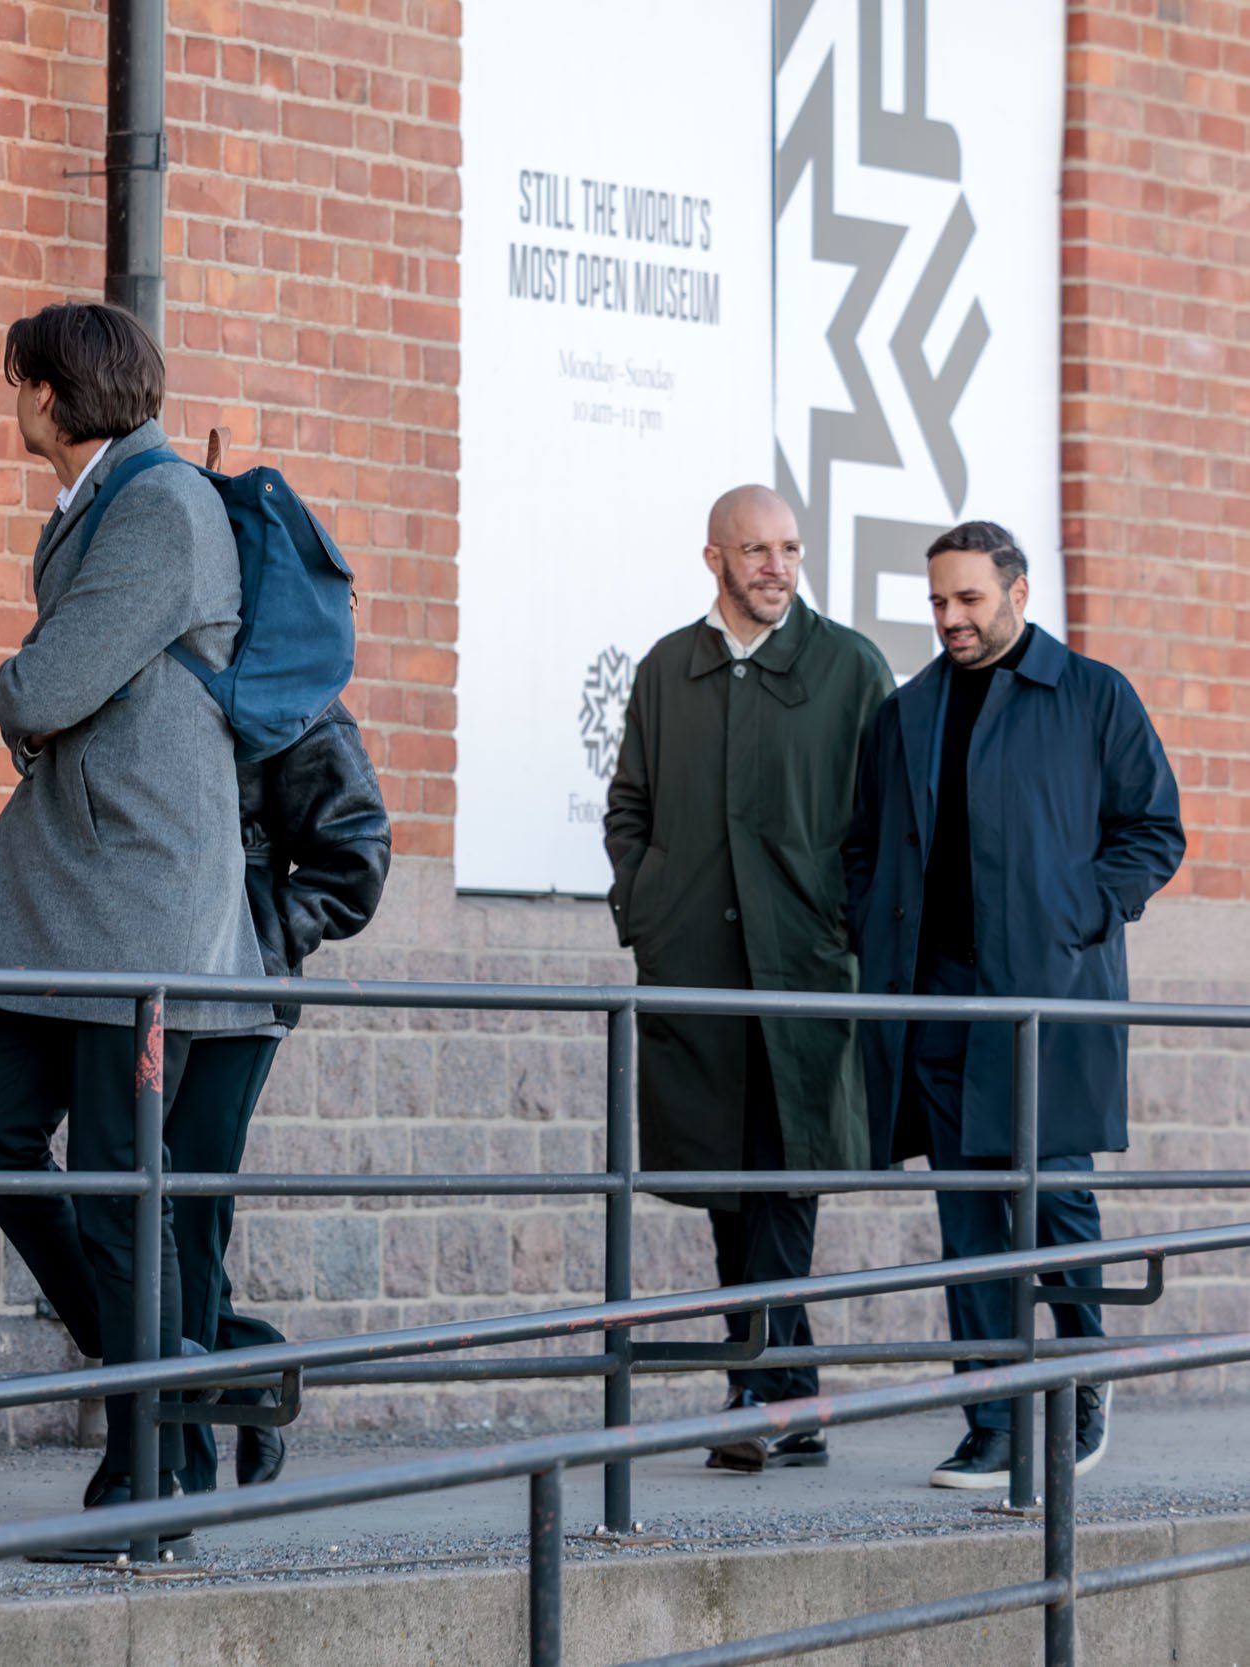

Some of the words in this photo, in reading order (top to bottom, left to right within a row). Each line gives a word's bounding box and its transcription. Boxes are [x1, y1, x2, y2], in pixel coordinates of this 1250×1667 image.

[519, 169, 574, 230] STILL
[581, 178, 617, 237] THE
[623, 184, 711, 251] WORLD'S
[509, 243, 569, 302] MOST
[576, 252, 627, 312] OPEN
[634, 260, 720, 325] MUSEUM
[639, 409, 662, 438] pm
